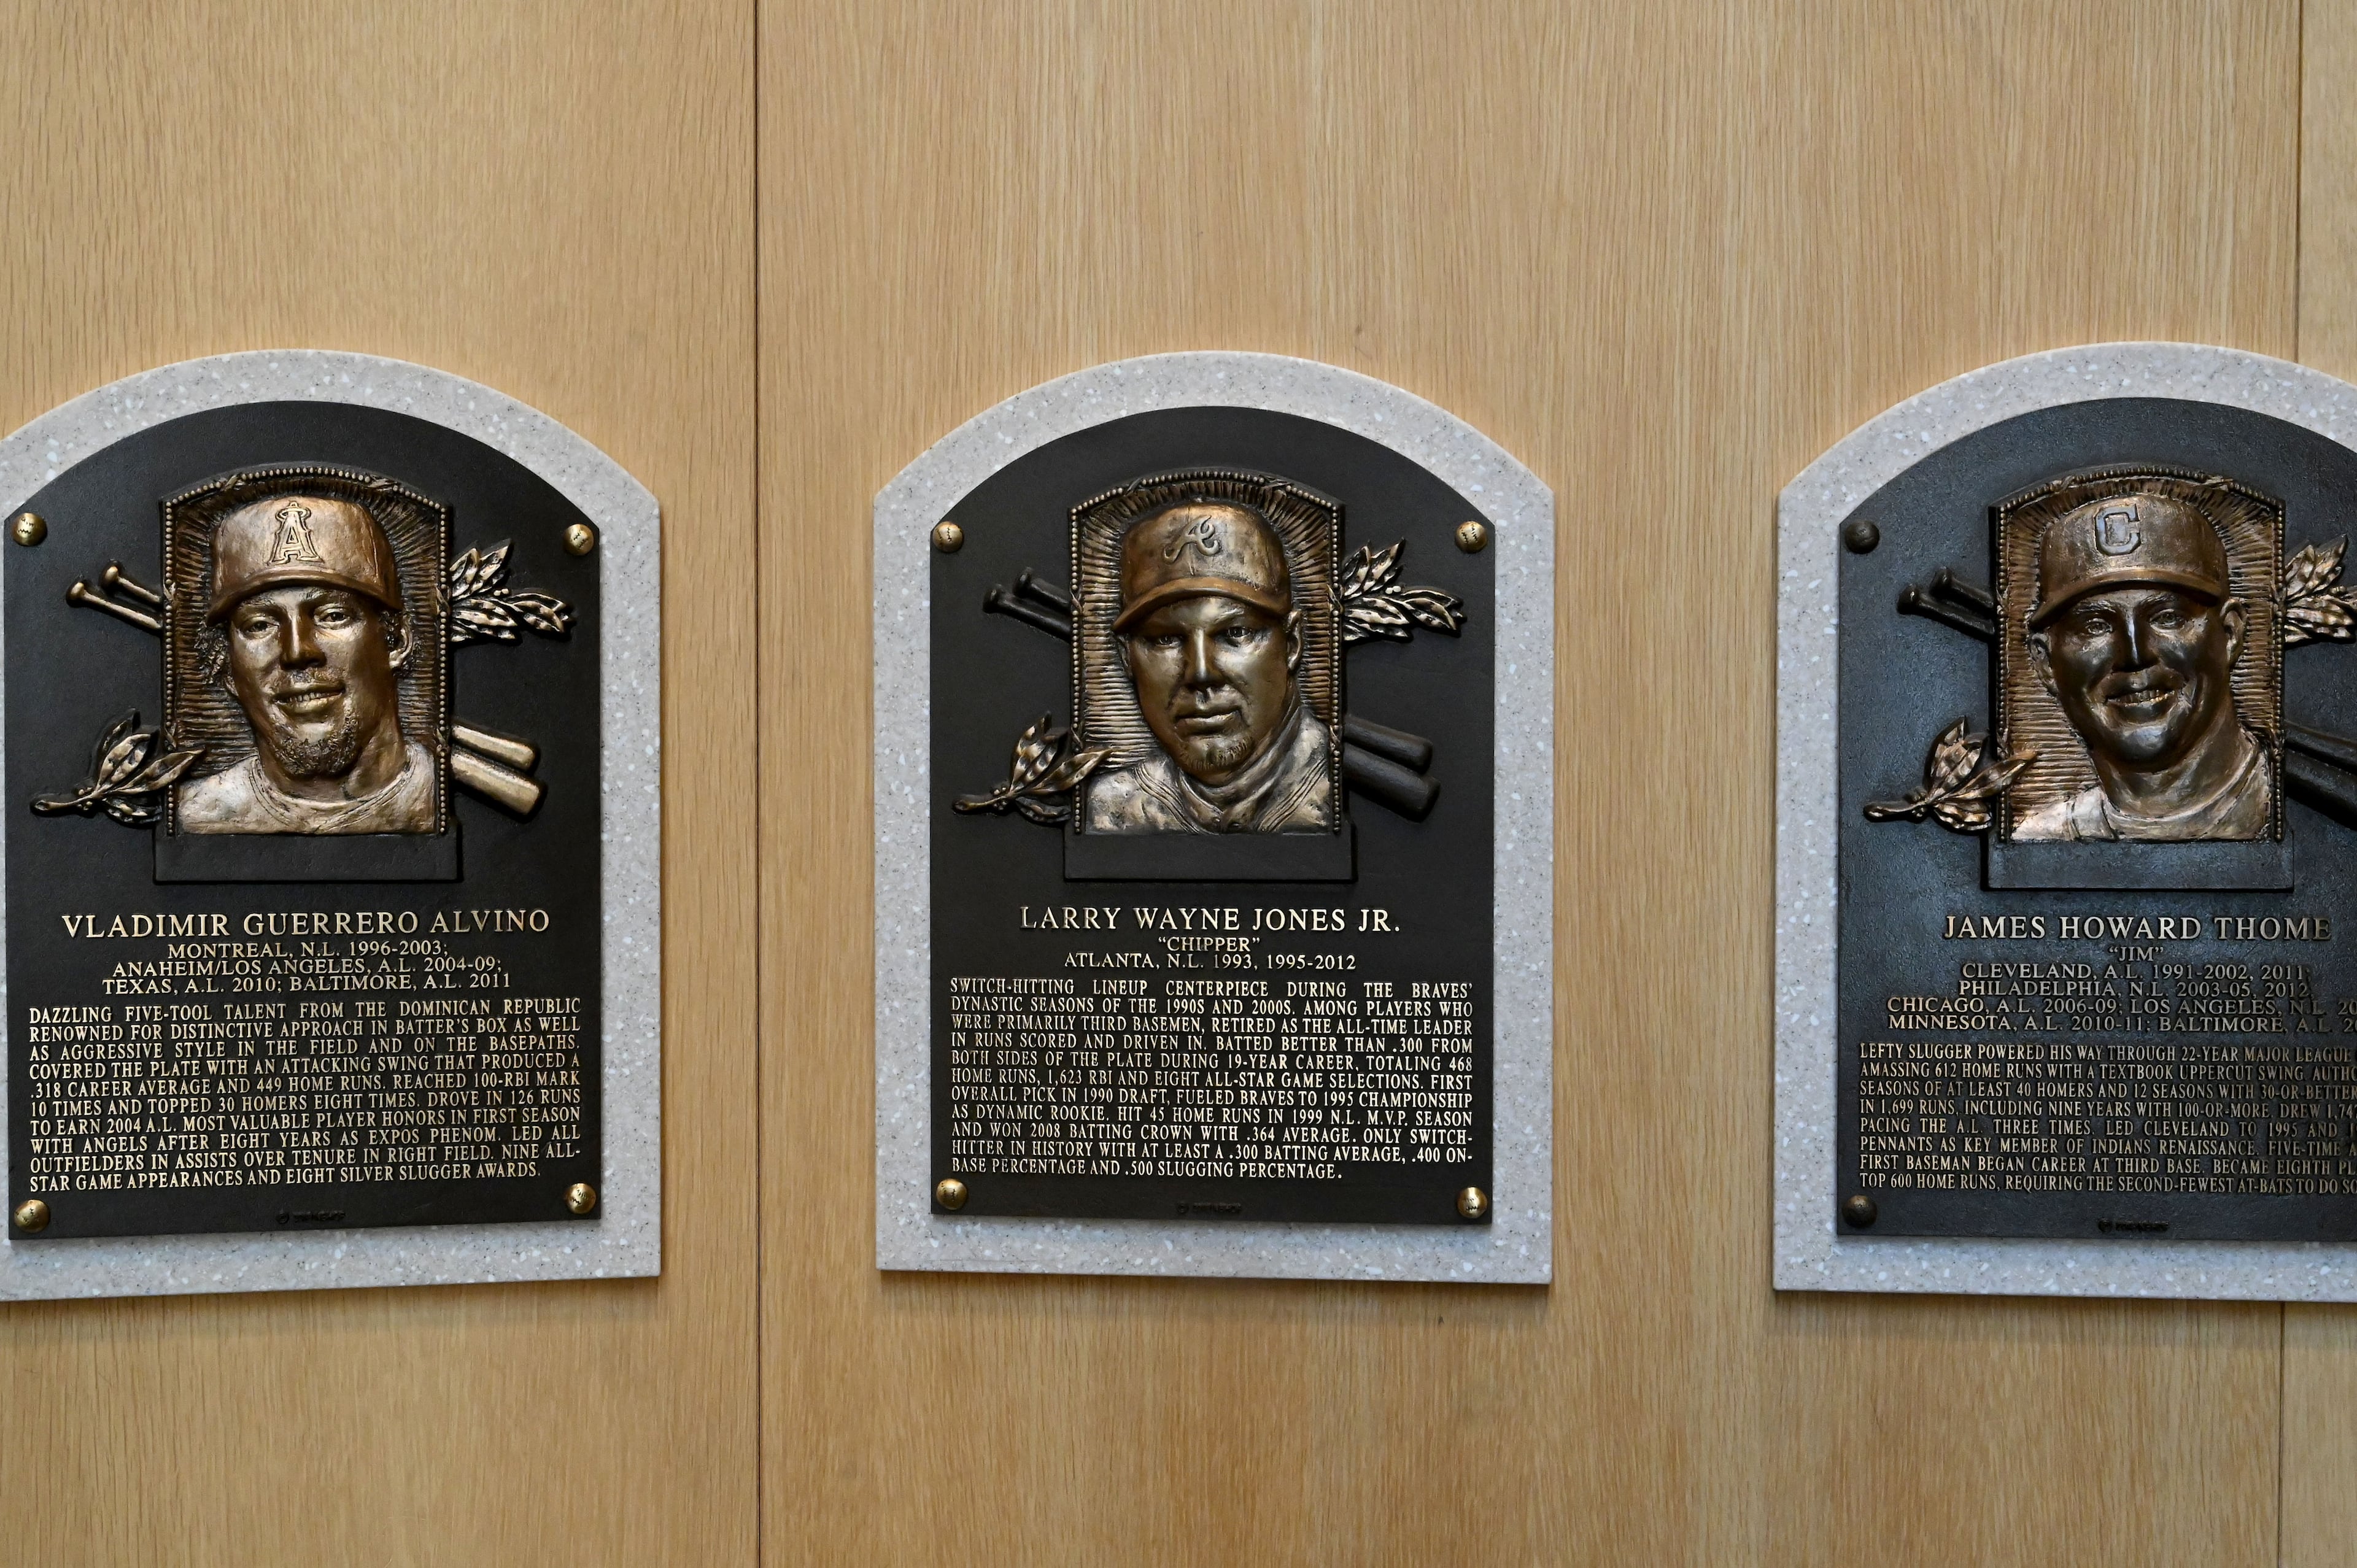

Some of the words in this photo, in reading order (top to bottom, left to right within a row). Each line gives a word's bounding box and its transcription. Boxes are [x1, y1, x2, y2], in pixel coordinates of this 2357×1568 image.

[62, 914, 230, 937] VLADIMIR
[244, 911, 417, 935] GUERRERO
[430, 908, 549, 932] ALVINO
[1021, 906, 1120, 929] LARRY
[1134, 908, 1239, 930] WAYNE
[1253, 908, 1344, 930] JONES
[1359, 910, 1399, 931] JR.
[1945, 916, 2045, 938] JAMES
[2060, 917, 2200, 938] HOWARD
[2214, 917, 2332, 940] THOME
[168, 943, 293, 959] MONTREAL,
[301, 942, 339, 956] N.L.
[350, 940, 447, 956] 1996-2003;
[113, 960, 261, 976] ANAHEIM/LOS
[269, 959, 371, 975] ANGELES,
[378, 958, 416, 972] A.L.
[425, 956, 501, 972] 2004-09;
[1065, 952, 1159, 969] ATLANTA,
[1167, 954, 1203, 968] N.L.
[1215, 954, 1258, 970] 1993,
[1268, 954, 1356, 969] 1995-2012
[1962, 963, 2097, 979] CLEVELAND,
[2104, 964, 2143, 979] A.L.
[2153, 964, 2254, 981] 1991-2002,
[103, 979, 177, 995] TEXAS,
[185, 978, 223, 992] A.L.
[233, 977, 281, 993] 2010;
[290, 975, 416, 991] BALTIMORE,
[424, 974, 461, 989] A.L.
[470, 973, 509, 987] 2011
[951, 978, 1074, 994] SWITCH-HITTING
[1094, 979, 1147, 995] LINEUP
[1166, 980, 1268, 996] CENTERPIECE
[1288, 981, 1346, 997] DURING
[1364, 983, 1393, 997] THE
[1959, 980, 2121, 997] PHILADELPHIA,
[2130, 983, 2168, 997] N.L.
[2177, 983, 2257, 999] 2003-05,
[29, 1006, 111, 1023] DAZZLING
[125, 1005, 212, 1021] FIVE-TOOL
[224, 1003, 285, 1019] TALENT
[300, 1002, 343, 1018] FROM
[355, 1002, 385, 1017] THE
[400, 1000, 489, 1016] DOMINICAN
[504, 997, 579, 1014] REPUBLIC
[952, 996, 1023, 1011] DYNASTIC
[1031, 997, 1094, 1012] SEASONS
[1103, 998, 1121, 1013] OF
[1129, 998, 1156, 1013] THE
[1168, 998, 1204, 1014] 1990S
[1213, 999, 1243, 1014] AND
[1253, 1000, 1295, 1014] 2000S.
[1304, 1000, 1357, 1015] AMONG
[1367, 1001, 1431, 1016] PLAYERS
[1439, 1002, 1473, 1016] WHO
[1887, 997, 1989, 1014] CHICAGO,
[1996, 998, 2035, 1013] A.L.
[2043, 998, 2123, 1014] 2006-09;
[2131, 999, 2170, 1013] LOS
[2179, 999, 2282, 1016] ANGELES,
[1888, 1014, 2018, 1032] MINNESOTA,
[2025, 1016, 2063, 1031] A.L.
[2159, 1017, 2287, 1034] BALTIMORE,
[29, 1045, 48, 1060] AS
[61, 1043, 162, 1060] AGGRESSIVE
[176, 1041, 225, 1057] STYLE
[238, 1041, 254, 1056] IN
[266, 1040, 296, 1055] THE
[310, 1039, 357, 1054] FIELD
[369, 1038, 401, 1053] AND
[414, 1037, 435, 1052] ON
[446, 1037, 477, 1051] THE
[489, 1035, 579, 1051] BASEPATHS.
[1860, 1043, 1903, 1058] LEFTY
[1909, 1044, 1972, 1059] SLUGGER
[1978, 1044, 2043, 1059] POWERED
[2050, 1045, 2071, 1059] HIS
[2077, 1045, 2102, 1060] WAY
[2108, 1045, 2175, 1060] THROUGH
[2181, 1046, 2238, 1061] 22-YEAR
[2245, 1046, 2289, 1061] MAJOR
[2296, 1047, 2351, 1062] LEAGUE
[29, 1063, 105, 1079] COVERED
[111, 1062, 142, 1077] THE
[150, 1060, 200, 1076] PLATE
[206, 1060, 247, 1075] WITH
[254, 1059, 274, 1074] AN
[281, 1057, 370, 1073] ATTACKING
[378, 1056, 428, 1071] SWING
[435, 1055, 474, 1070] THAT
[482, 1052, 565, 1068] PRODUCED
[571, 1053, 579, 1067] A
[952, 1050, 989, 1065] BOTH
[997, 1051, 1037, 1065] SIDES
[1046, 1051, 1064, 1065] OF
[1070, 1052, 1098, 1066] THE
[1108, 1052, 1152, 1067] PLATE
[1161, 1053, 1218, 1068] DURING
[1229, 1054, 1287, 1069] 19-YEAR
[1296, 1054, 1358, 1071] CAREER,
[1366, 1056, 1441, 1071] TOTALING
[1450, 1057, 1472, 1071] 468
[953, 1122, 981, 1136] AND
[990, 1122, 1021, 1137] WON
[1032, 1123, 1060, 1137] 2008
[1070, 1124, 1132, 1139] BATTING
[1141, 1124, 1192, 1140] CROWN
[1201, 1126, 1238, 1140] WITH
[1247, 1127, 1275, 1141] .364
[1283, 1127, 1356, 1142] AVERAGE.
[1364, 1128, 1402, 1143] ONLY
[1411, 1129, 1473, 1144] SWITCH-
[1861, 1136, 1932, 1151] PENNANTS
[1940, 1137, 1955, 1151] AS
[1965, 1137, 1991, 1152] KEY
[2000, 1138, 2057, 1153] MEMBER
[2067, 1138, 2083, 1153] OF
[2092, 1138, 2150, 1154] INDIANS
[2159, 1140, 2259, 1155] RENAISSANCE.
[2269, 1140, 2341, 1156] FIVE-TIME
[31, 1154, 144, 1173] OUTFIELDERS
[152, 1154, 168, 1169] IN
[175, 1152, 236, 1168] ASSISTS
[244, 1151, 285, 1166] OVER
[292, 1149, 355, 1165] TENURE
[363, 1148, 379, 1163] IN
[388, 1146, 436, 1162] RIGHT
[444, 1145, 493, 1161] FIELD.
[501, 1144, 539, 1159] NINE
[546, 1143, 580, 1157] ALL-
[953, 1157, 986, 1172] BASE
[993, 1159, 1085, 1173] PERCENTAGE
[1091, 1160, 1120, 1175] AND
[1126, 1161, 1153, 1175] .500
[1158, 1161, 1233, 1177] SLUGGING
[1240, 1162, 1342, 1178] PERCENTAGE.
[1860, 1173, 1885, 1187] TOP
[1891, 1173, 1911, 1188] 600
[1917, 1173, 1954, 1188] HOME
[1960, 1174, 1999, 1191] RUNS,
[2005, 1175, 2082, 1193] REQUIRING
[2087, 1176, 2113, 1191] THE
[2119, 1176, 2234, 1192] SECOND-FEWEST
[2238, 1178, 2292, 1193] AT-BATS
[2296, 1179, 2313, 1193] TO
[2319, 1179, 2337, 1193] DO
